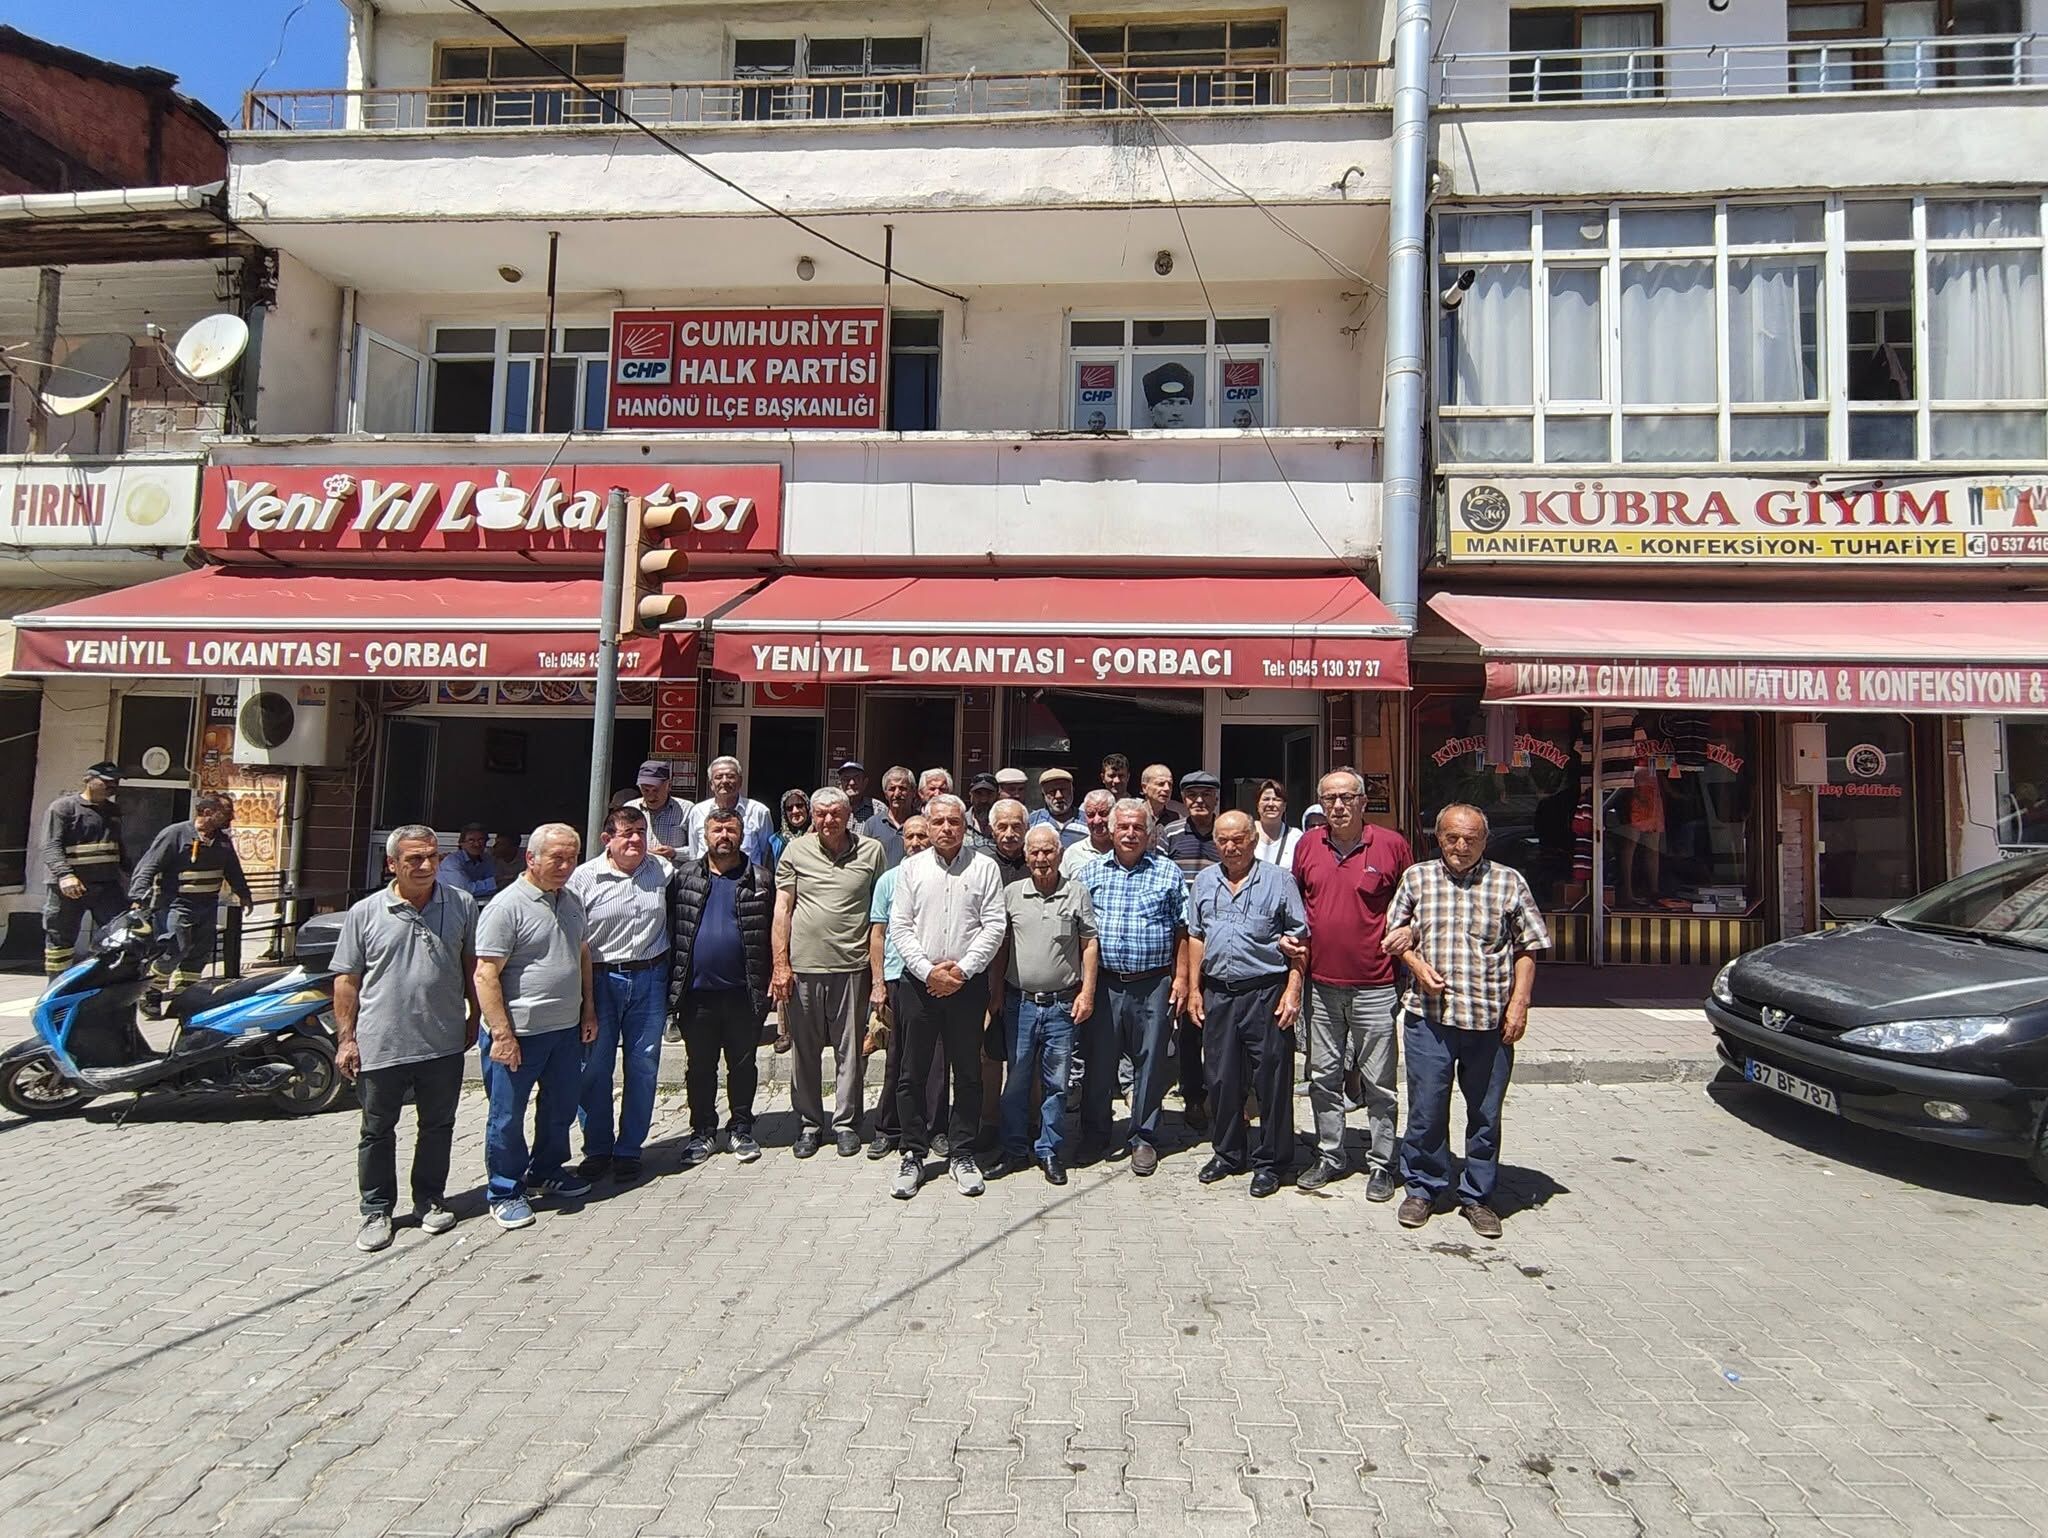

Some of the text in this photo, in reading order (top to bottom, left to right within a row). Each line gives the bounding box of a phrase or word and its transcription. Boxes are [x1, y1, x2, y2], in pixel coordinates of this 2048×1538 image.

[681, 314, 879, 347] CUMHURİYET
[622, 362, 667, 379] CHP
[679, 352, 876, 385] HALK PARTİSİ
[616, 393, 874, 421] HANÖNÜ İLÇE BAŞKANLIĞI
[1082, 390, 1113, 402] CHP
[1226, 388, 1258, 400] CHP
[11, 483, 106, 526] FIRINI
[217, 474, 357, 532] Yeni
[351, 479, 440, 532] Yıl
[1521, 479, 1954, 527] KÜBRA GİYİM
[1466, 535, 1618, 555] MANİFATURA
[1832, 536, 1957, 555] TUHAFİYE
[1990, 537, 1998, 551] 0
[2002, 537, 2025, 551] 537
[65, 635, 171, 666] YENİYIL
[187, 641, 341, 668] LOKANTASI
[365, 642, 487, 673] ÇORBACI
[538, 652, 558, 668] Tel:
[560, 652, 586, 668] 0545
[589, 652, 600, 668] 13
[627, 652, 640, 668] 37
[752, 640, 869, 673] YENİYIL
[891, 647, 1065, 676] LOKANTASI
[1091, 647, 1233, 681] ÇORBACI
[1263, 660, 1380, 677] Tel: 0545 130 37 37
[1517, 659, 2046, 703] KÜBRA GİYİM & MANİFATURA & KONFEKSİYON &
[211, 707, 238, 717] EKME
[1431, 735, 1488, 767] KÜBR
[1753, 1063, 1831, 1108] 37 BF 787
